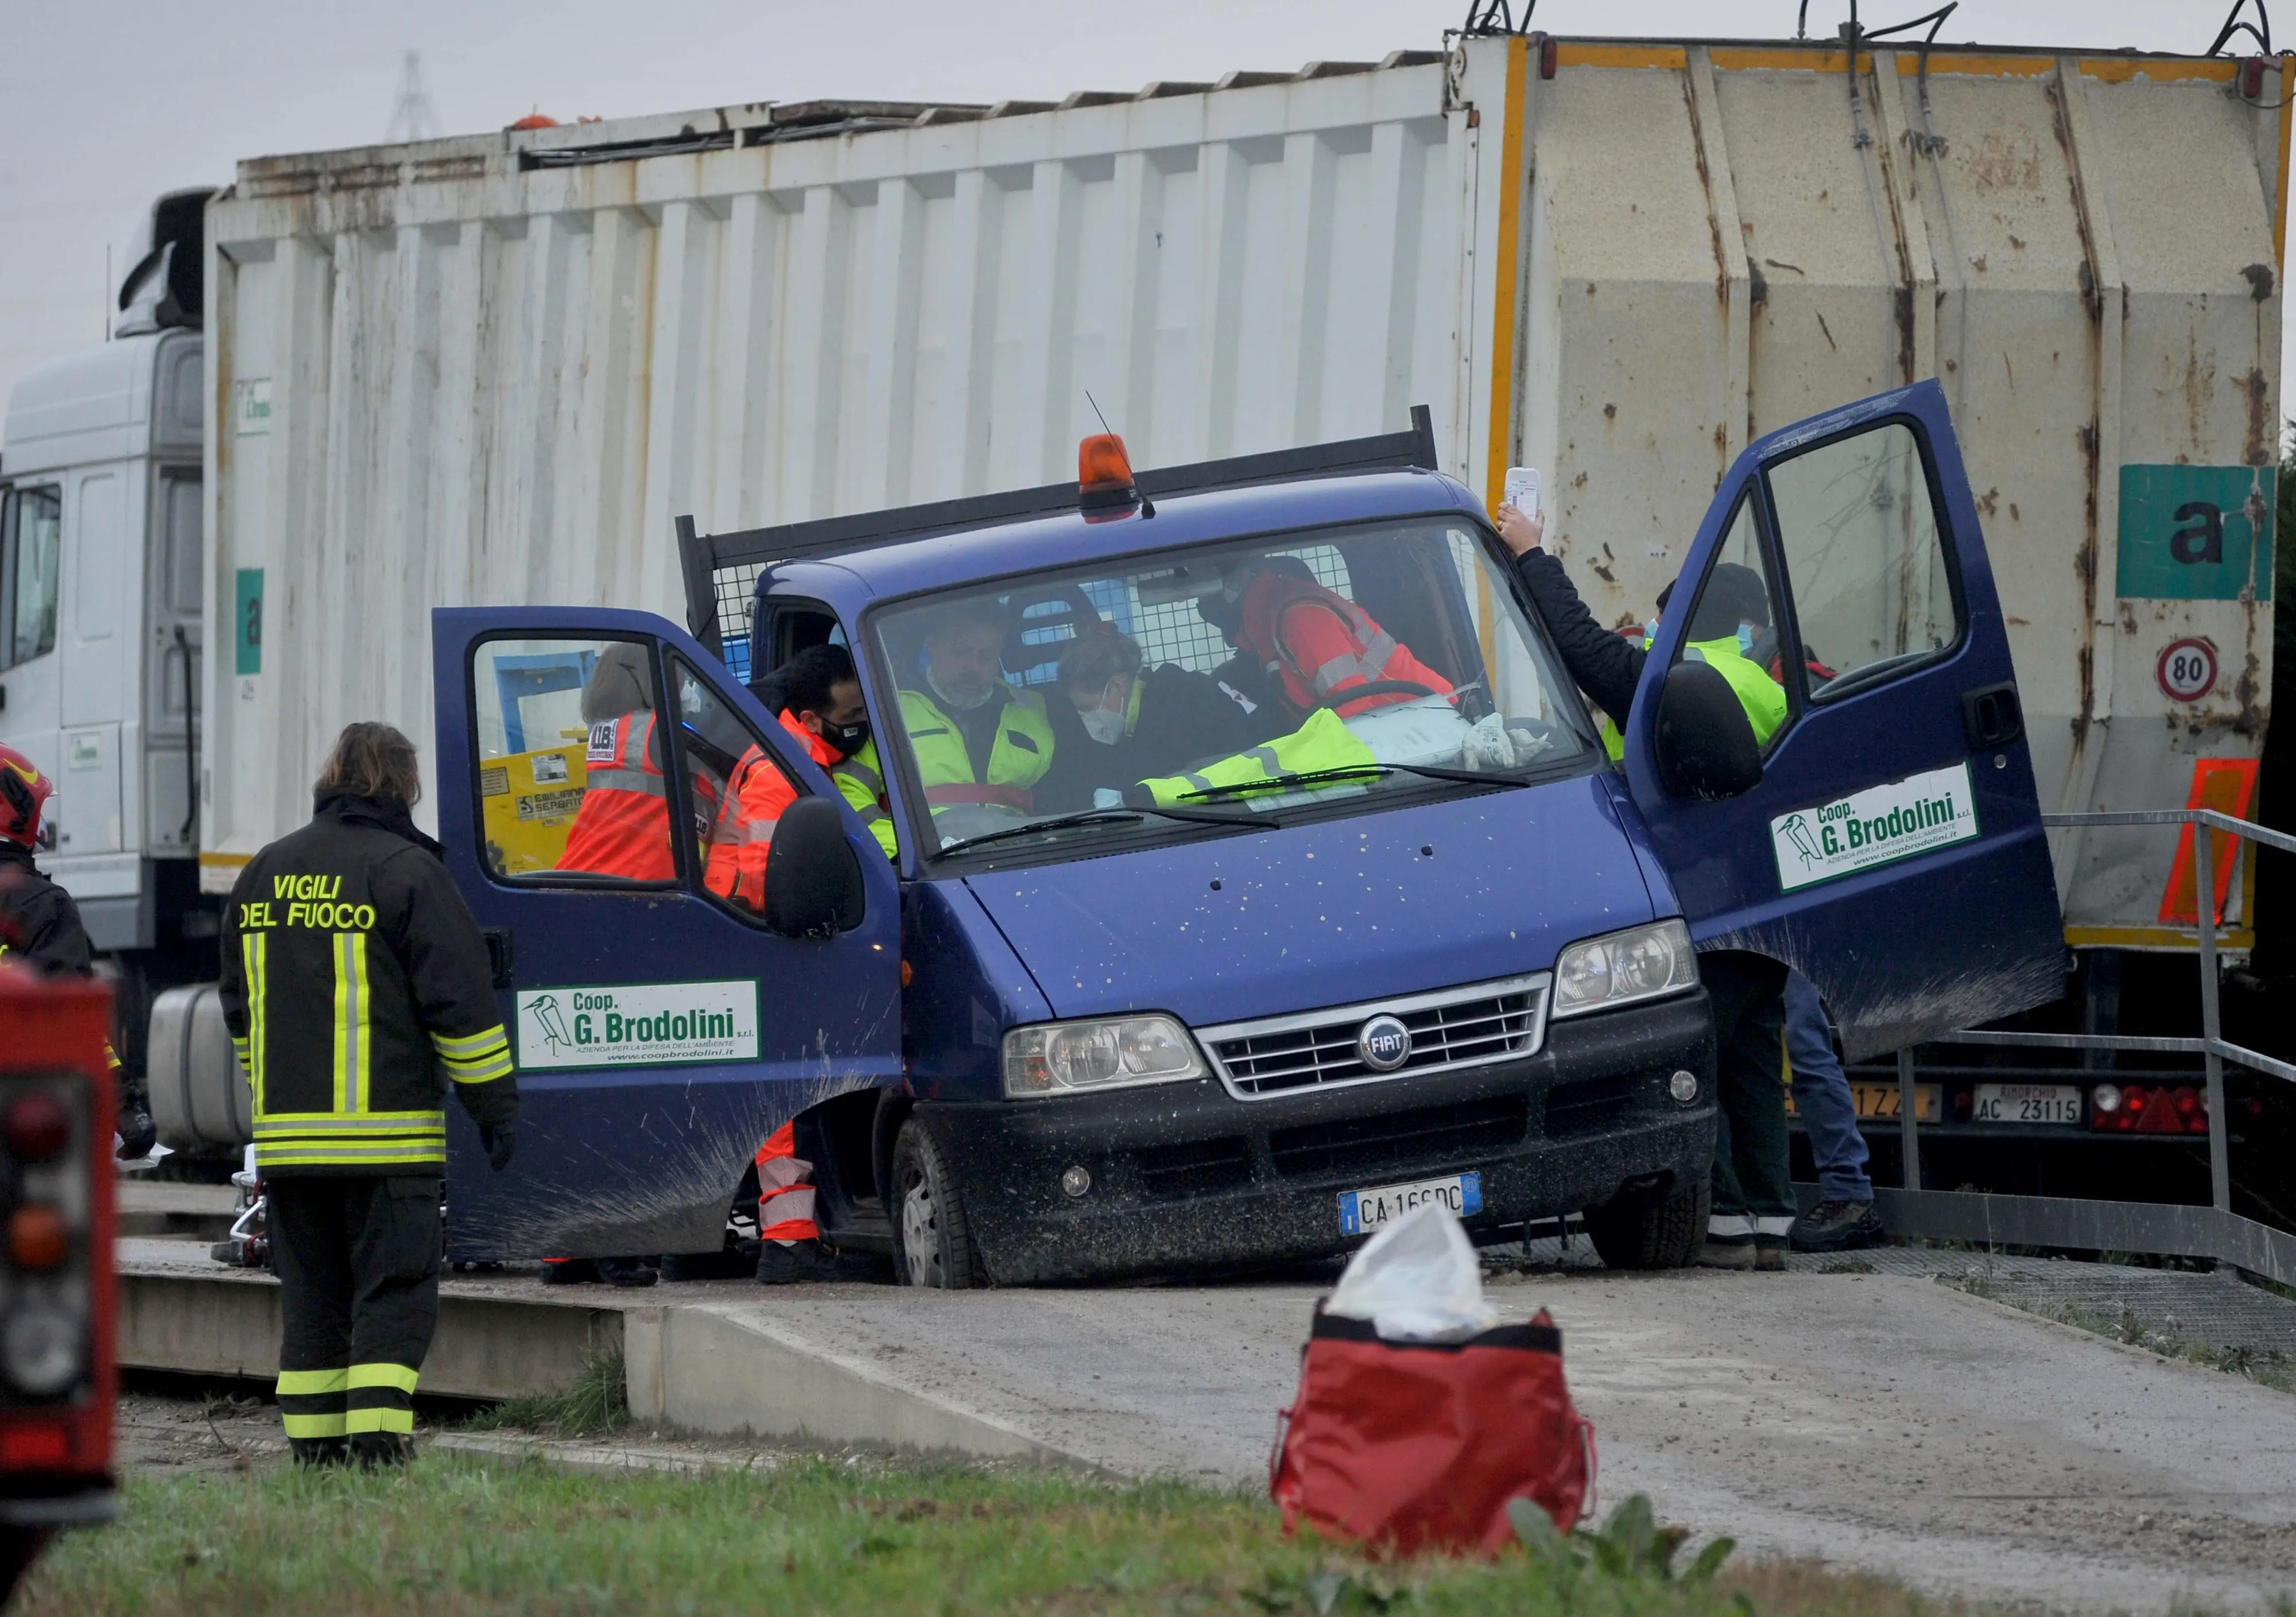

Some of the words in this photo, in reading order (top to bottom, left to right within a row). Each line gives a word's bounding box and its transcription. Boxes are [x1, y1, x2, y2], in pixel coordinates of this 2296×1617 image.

[2170, 501, 2223, 564] a
[2173, 655, 2203, 682] 80
[1817, 802, 1856, 824] Coop.
[1821, 825, 1845, 856] G.
[1847, 792, 1954, 849] Brodolini
[1957, 809, 1972, 819] s.r.l.
[1827, 852, 1856, 865] AZIENDA
[1856, 847, 1870, 856] PER
[1881, 837, 1905, 850] DIFESA
[1906, 823, 1957, 842] DELL'AMBIENTE
[1853, 831, 1957, 866] www.coopbrodolini.it
[274, 875, 341, 900] VIGILI
[287, 902, 375, 930] FUOCO
[573, 992, 619, 1011] Coop.
[575, 1014, 600, 1045] G.
[606, 1007, 734, 1044] Brodolini
[737, 1029, 754, 1038] s.r.l.
[607, 1048, 734, 1061] www.coopbrodolini.it
[672, 1040, 734, 1049] DELL'AMBIENTE
[1370, 1033, 1401, 1053] FIAT
[1979, 1098, 2002, 1119] AC
[2020, 1099, 2077, 1120] 23115
